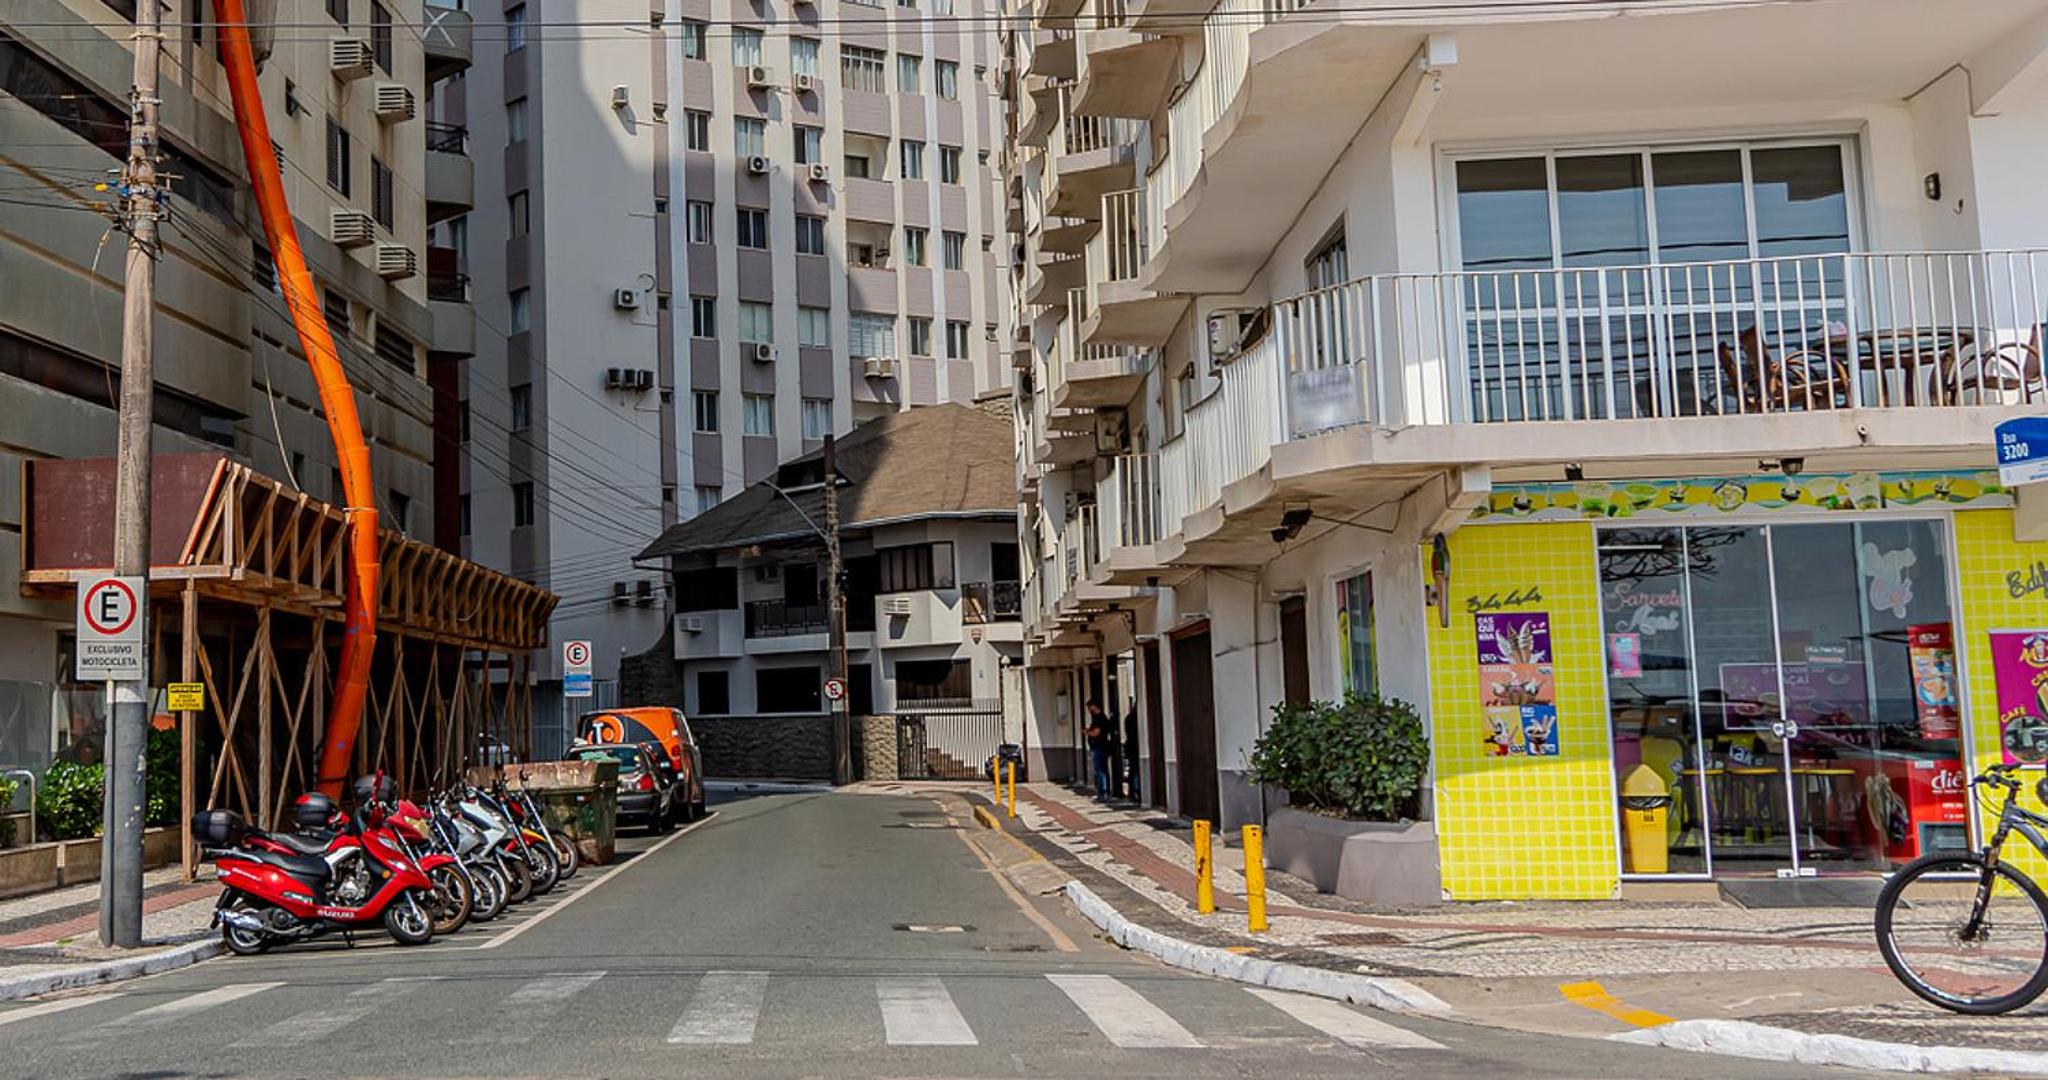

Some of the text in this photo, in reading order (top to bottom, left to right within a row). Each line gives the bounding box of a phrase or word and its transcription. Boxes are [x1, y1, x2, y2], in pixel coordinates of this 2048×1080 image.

[2003, 442, 2029, 460] 3200
[101, 591, 119, 622] E
[87, 645, 132, 655] EXCLUSIVO
[573, 647, 582, 660] E
[82, 657, 137, 666] MOTOCICLETA
[2000, 704, 2027, 724] CAFÉ
[316, 908, 355, 919] SUZUKI
